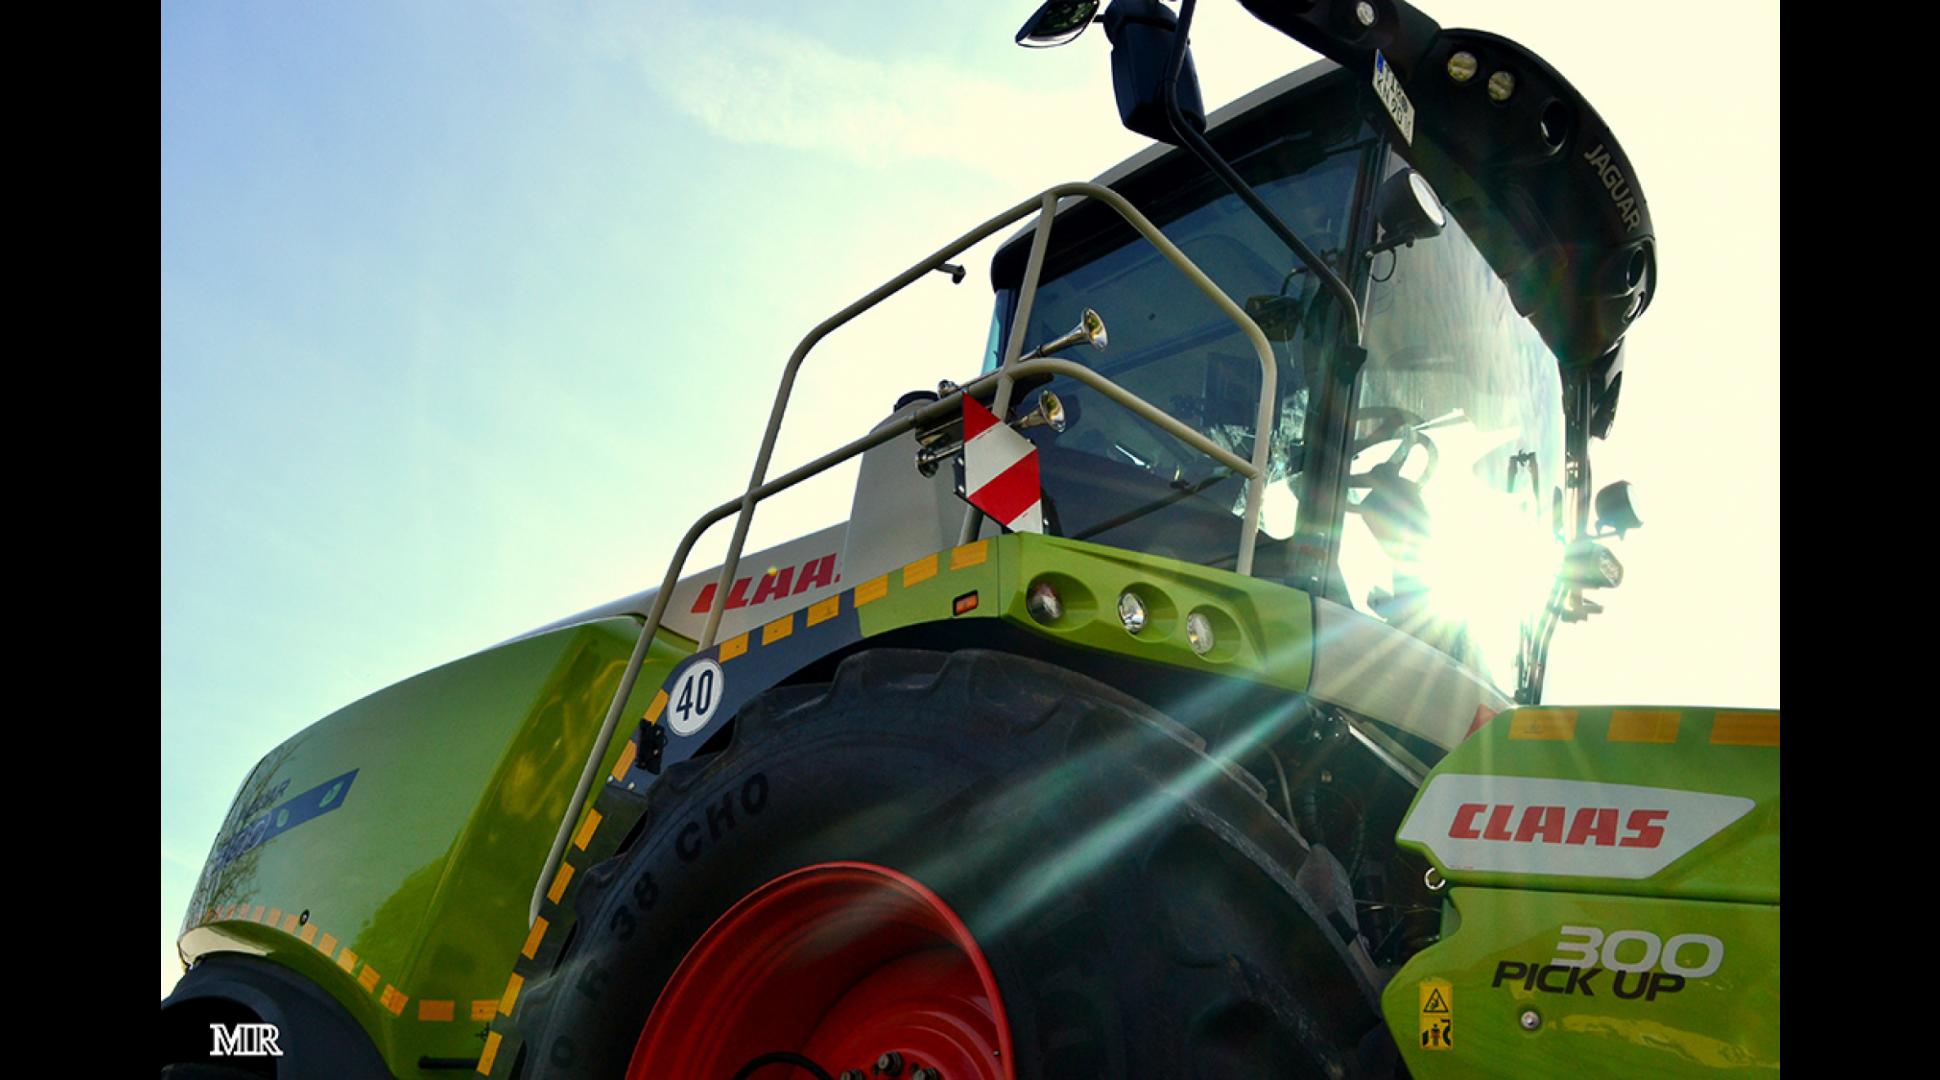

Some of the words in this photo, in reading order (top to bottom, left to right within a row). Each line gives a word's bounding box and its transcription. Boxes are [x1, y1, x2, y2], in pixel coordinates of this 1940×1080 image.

[1583, 144, 1641, 233] JAGUAR
[690, 553, 843, 614] CLAA
[676, 669, 713, 721] 40
[1448, 803, 1669, 848] CLAAS
[610, 872, 659, 941] 38
[675, 772, 769, 862] CHO
[1550, 925, 1724, 978] 300
[1491, 961, 1603, 997] PICK
[1613, 969, 1685, 1002] UP
